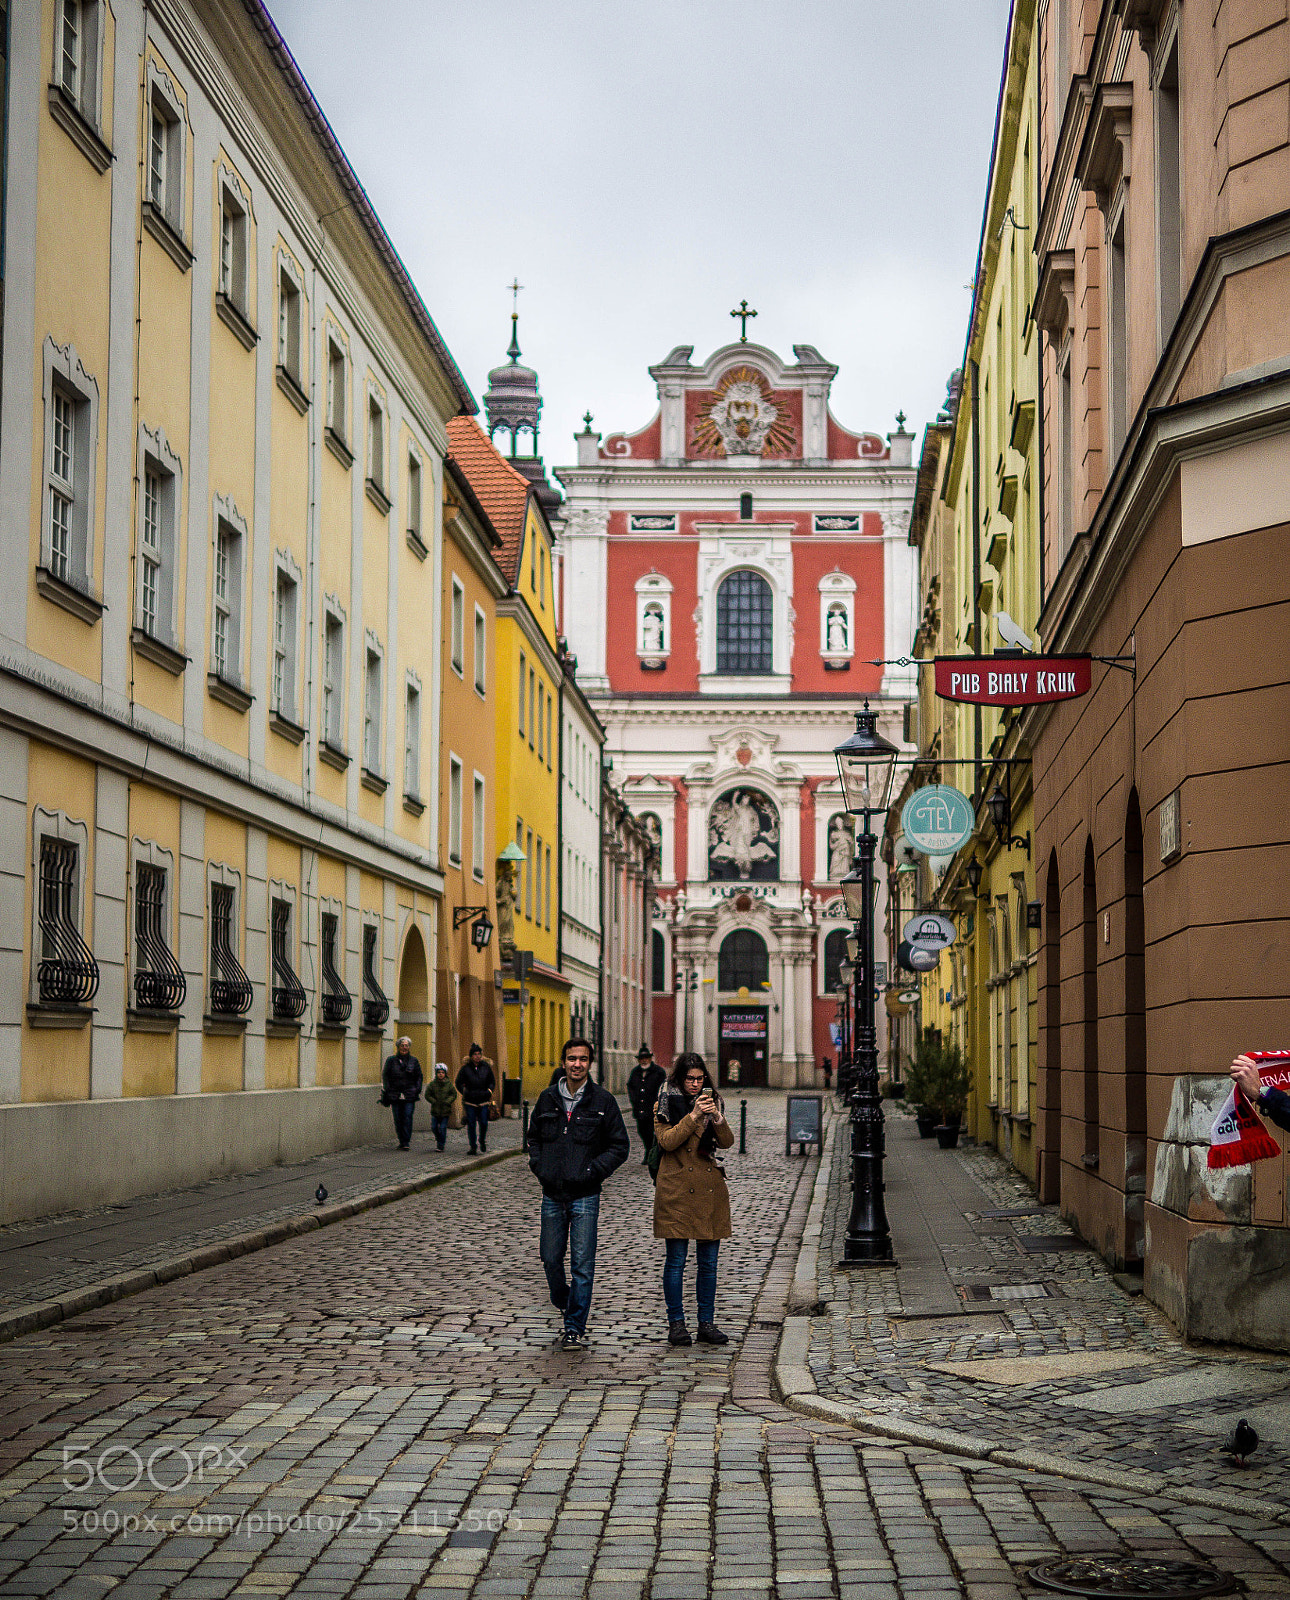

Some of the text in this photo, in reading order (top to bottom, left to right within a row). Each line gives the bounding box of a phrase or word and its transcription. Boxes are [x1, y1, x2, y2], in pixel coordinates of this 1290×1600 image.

[951, 672, 980, 695] PUB
[1036, 671, 1076, 694] KRUK
[916, 796, 955, 831] TEY
[477, 928, 483, 937] 2
[1217, 1118, 1258, 1135] adidas
